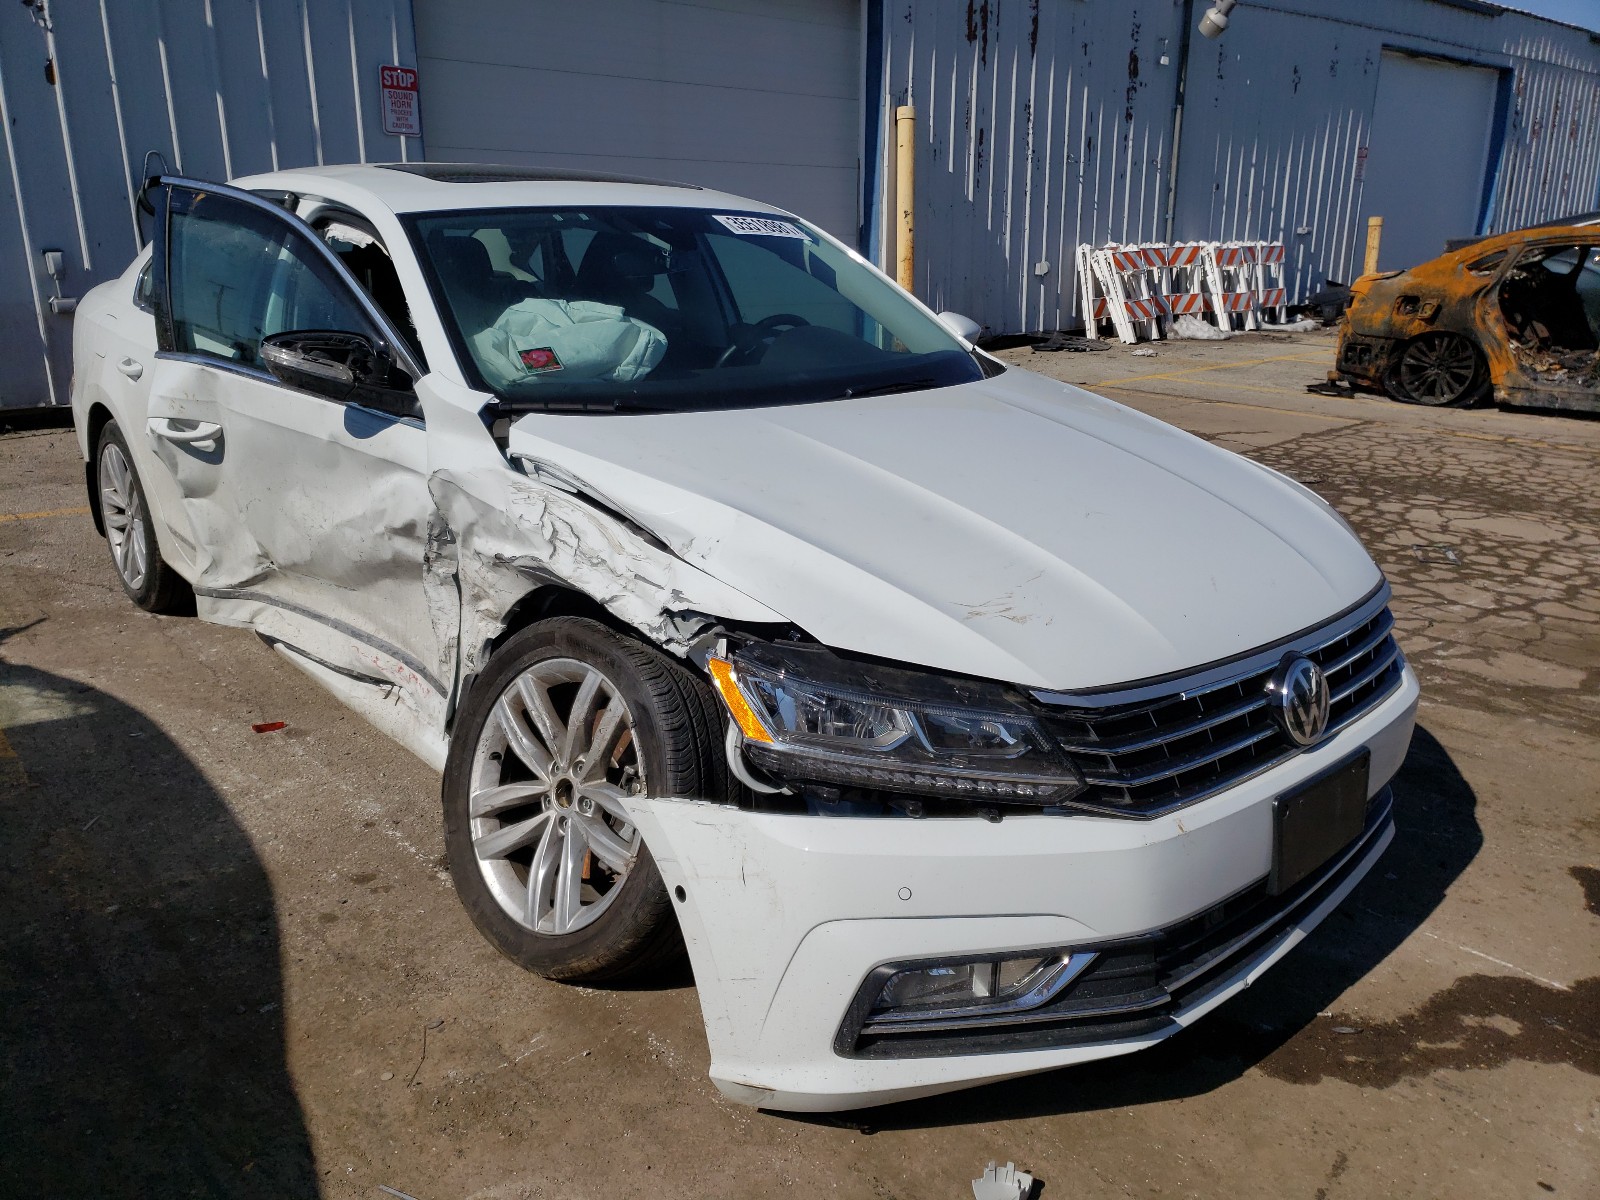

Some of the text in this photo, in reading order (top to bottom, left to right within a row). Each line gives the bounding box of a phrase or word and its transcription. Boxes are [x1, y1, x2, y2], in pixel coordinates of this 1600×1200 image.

[383, 70, 414, 87] STOP
[388, 90, 413, 100] SOUND
[391, 100, 412, 109] HORN
[392, 121, 413, 129] CAUTION
